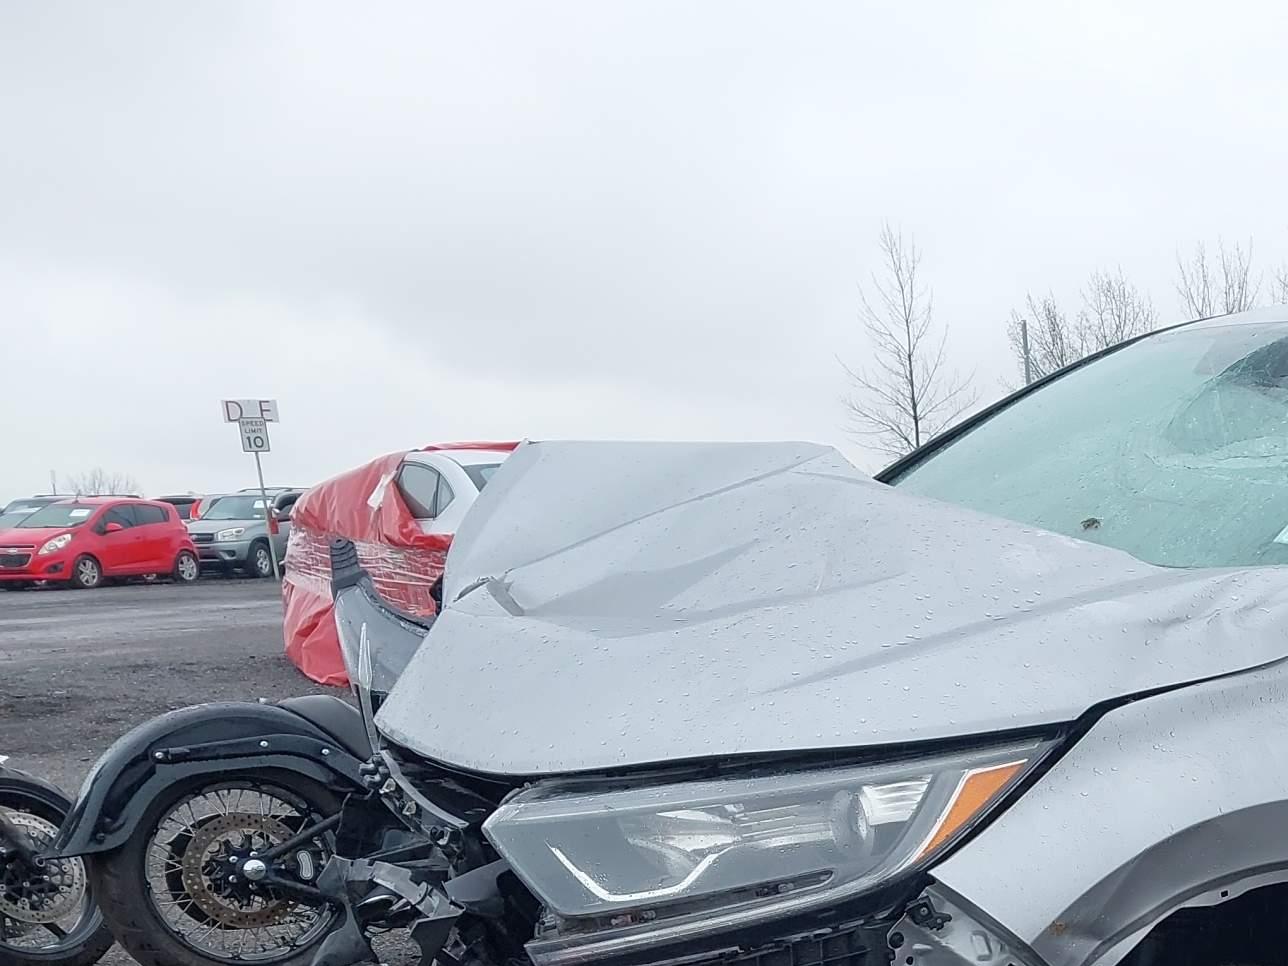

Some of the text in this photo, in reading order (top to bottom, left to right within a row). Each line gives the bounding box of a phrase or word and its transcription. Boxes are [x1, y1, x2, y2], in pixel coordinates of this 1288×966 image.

[225, 400, 273, 422] D E
[246, 435, 264, 449] 10
